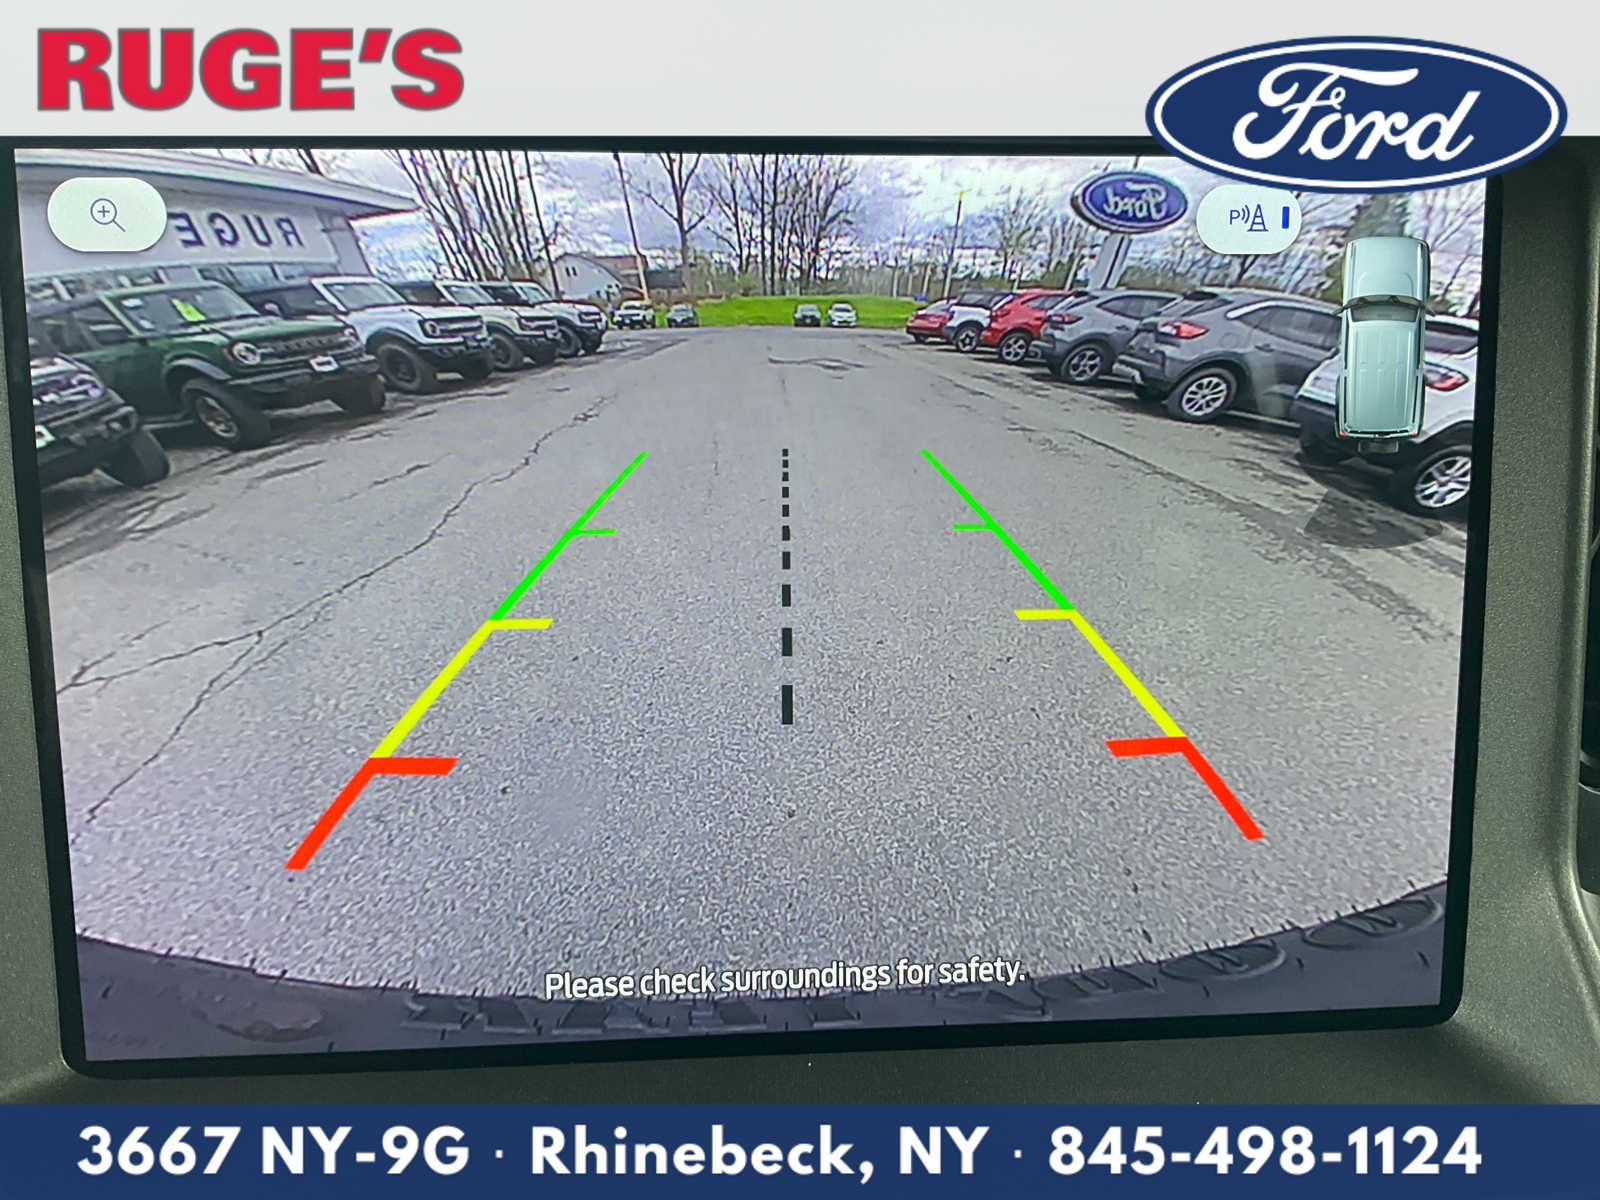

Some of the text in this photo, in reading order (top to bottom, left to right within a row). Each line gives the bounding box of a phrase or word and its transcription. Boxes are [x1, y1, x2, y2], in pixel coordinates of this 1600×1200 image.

[544, 954, 1026, 999] Please check surroundings for safety.
